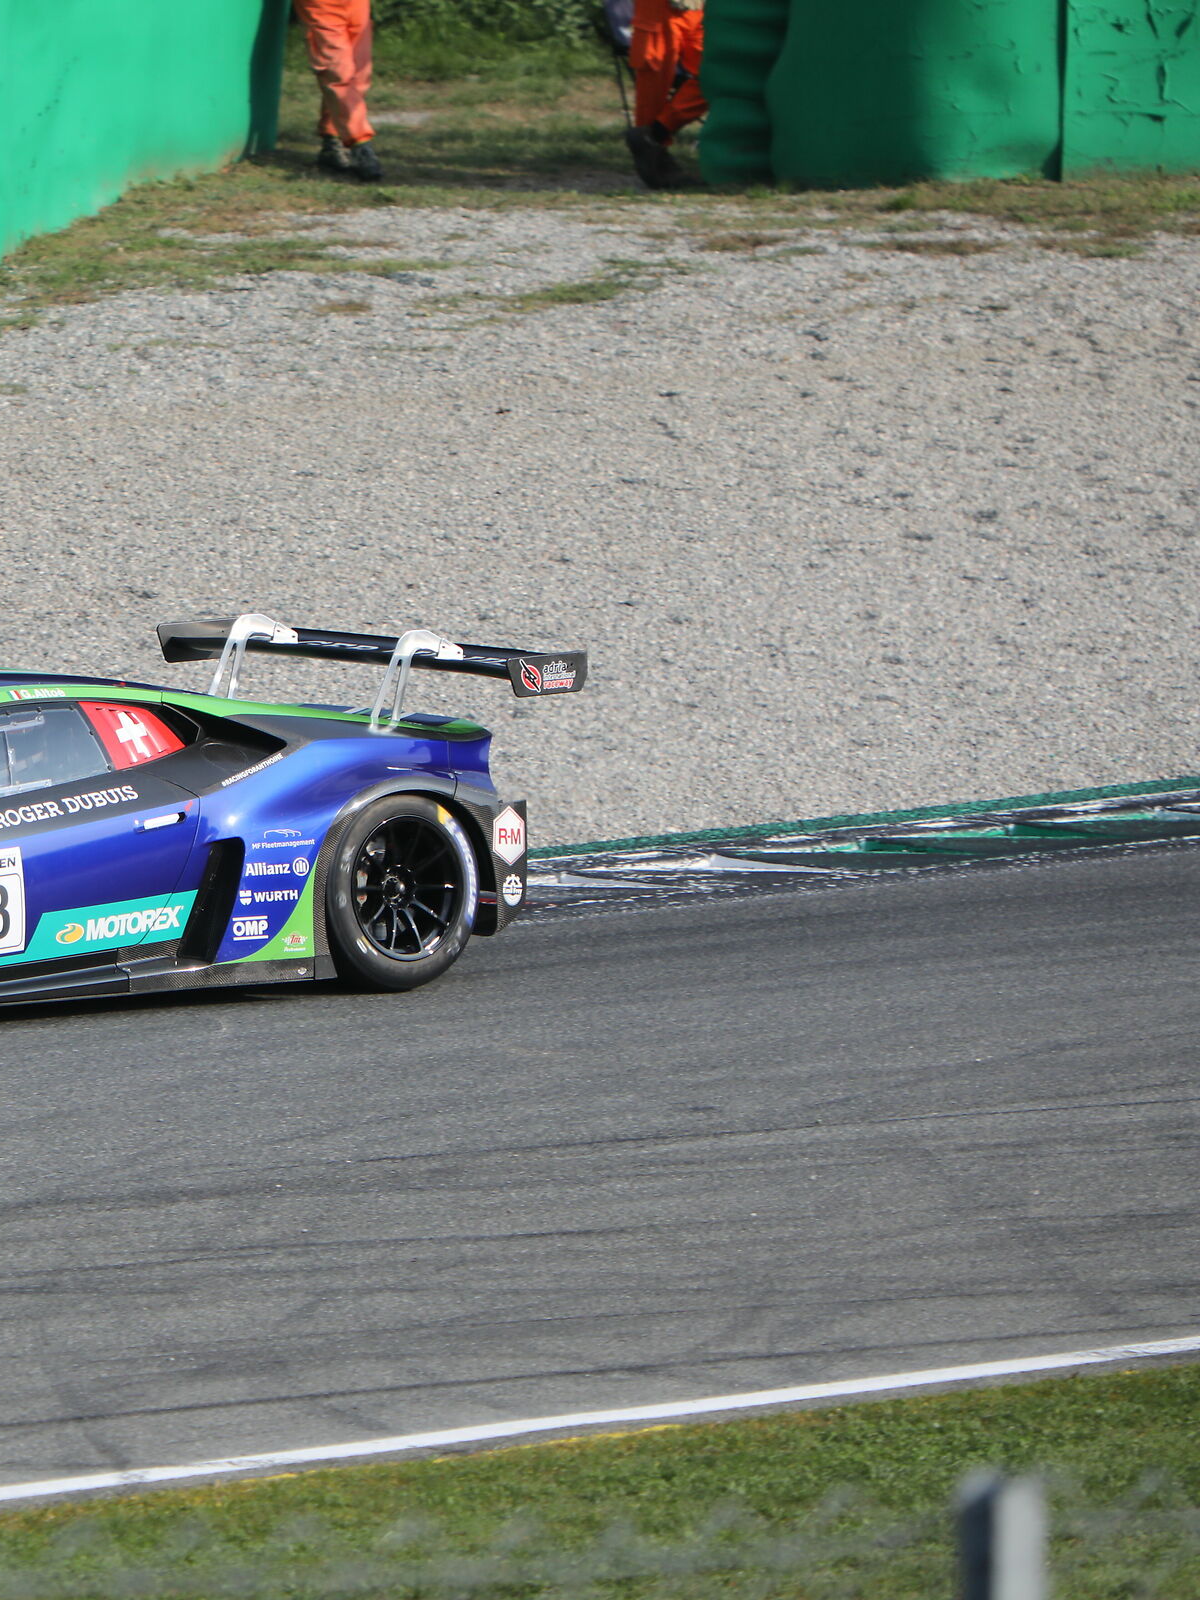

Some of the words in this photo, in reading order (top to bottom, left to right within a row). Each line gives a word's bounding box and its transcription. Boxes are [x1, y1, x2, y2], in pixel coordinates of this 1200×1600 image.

[61, 785, 139, 814] DUBUIS
[262, 839, 315, 849] Fleetmanagement
[245, 862, 291, 877] Allianz
[85, 905, 181, 942] MOTOREX
[233, 919, 269, 937] OMP
